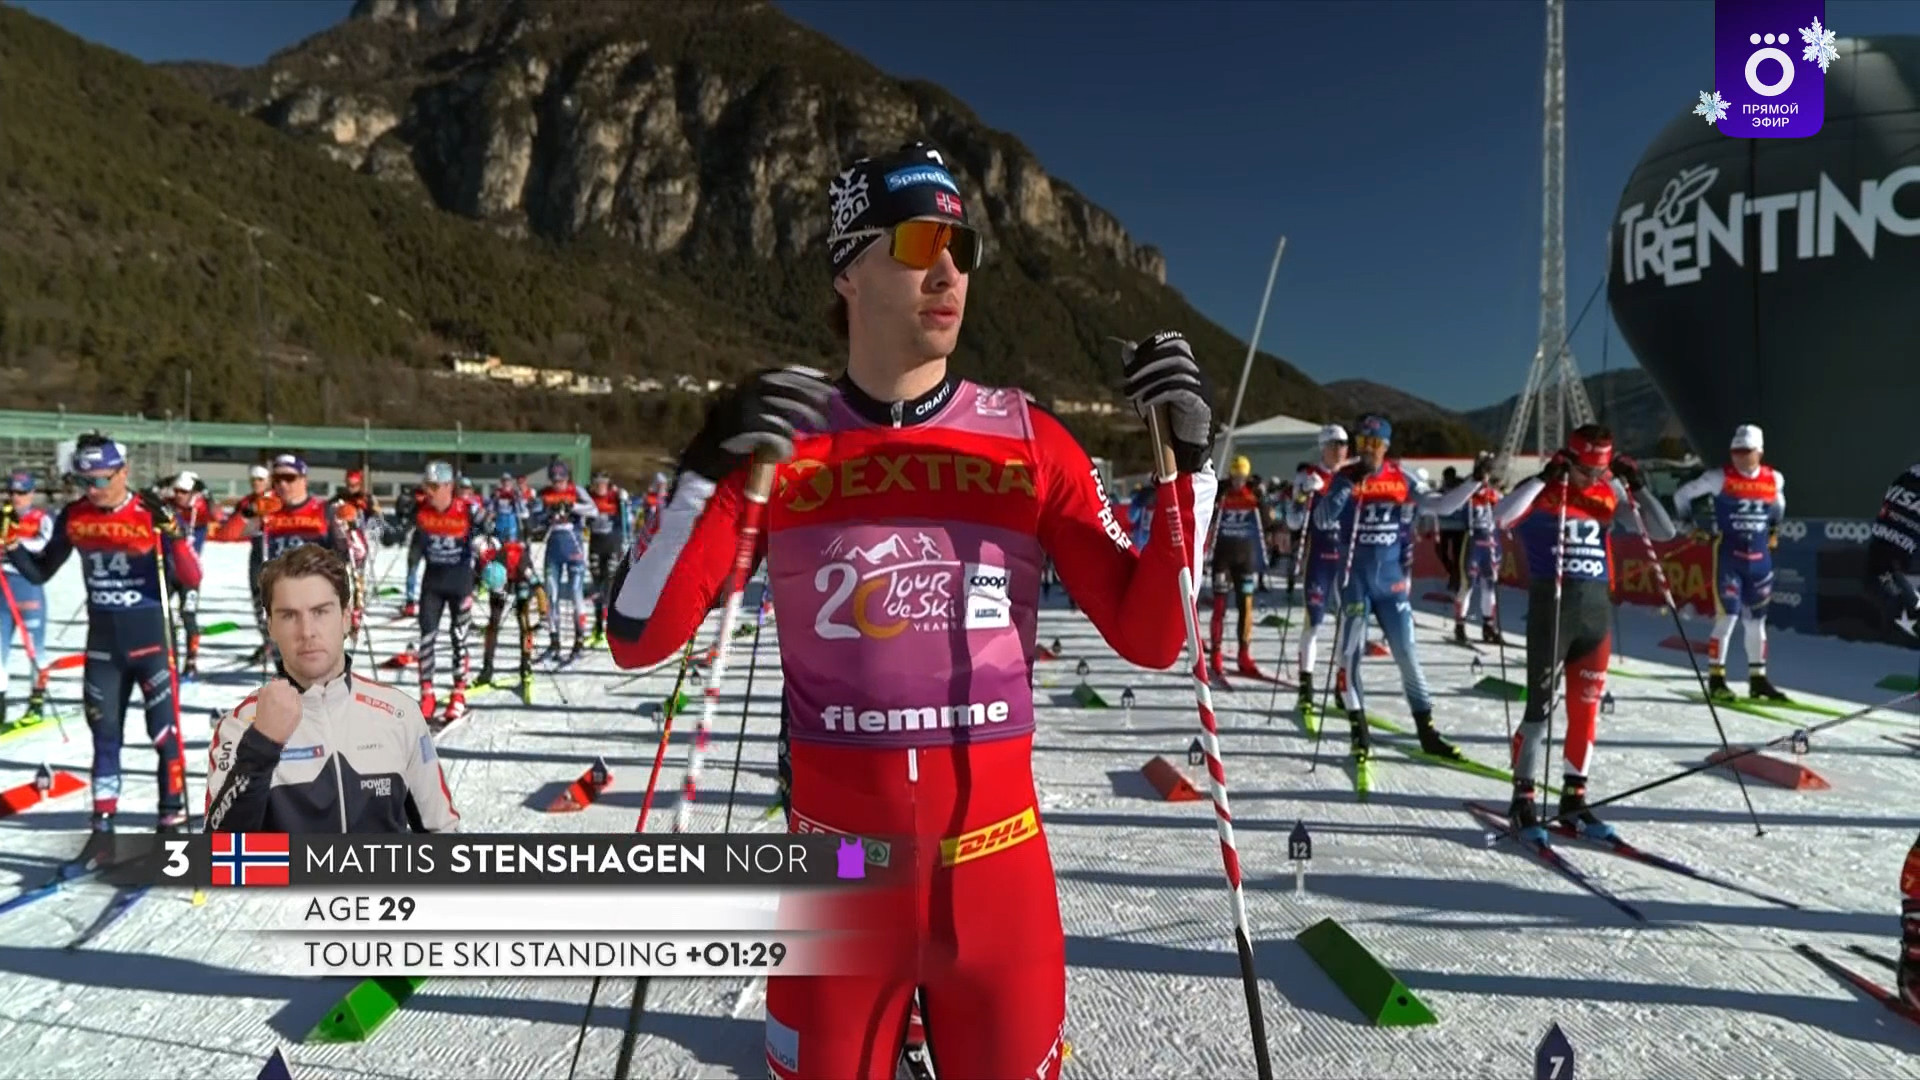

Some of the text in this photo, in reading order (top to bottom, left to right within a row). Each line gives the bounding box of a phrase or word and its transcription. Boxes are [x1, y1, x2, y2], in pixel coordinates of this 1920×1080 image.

[840, 454, 1038, 498] EXTRA
[1365, 503, 1395, 523] 17
[1359, 532, 1398, 546] coop
[1564, 518, 1601, 546] 12
[1824, 521, 1872, 544] coop
[89, 551, 131, 577] 14
[970, 576, 1007, 589] coop
[820, 700, 1010, 732] fiemme
[360, 778, 391, 789] POWER
[958, 817, 1029, 858] DHL
[1292, 841, 1308, 858] 12
[1550, 1055, 1566, 1080] 7
